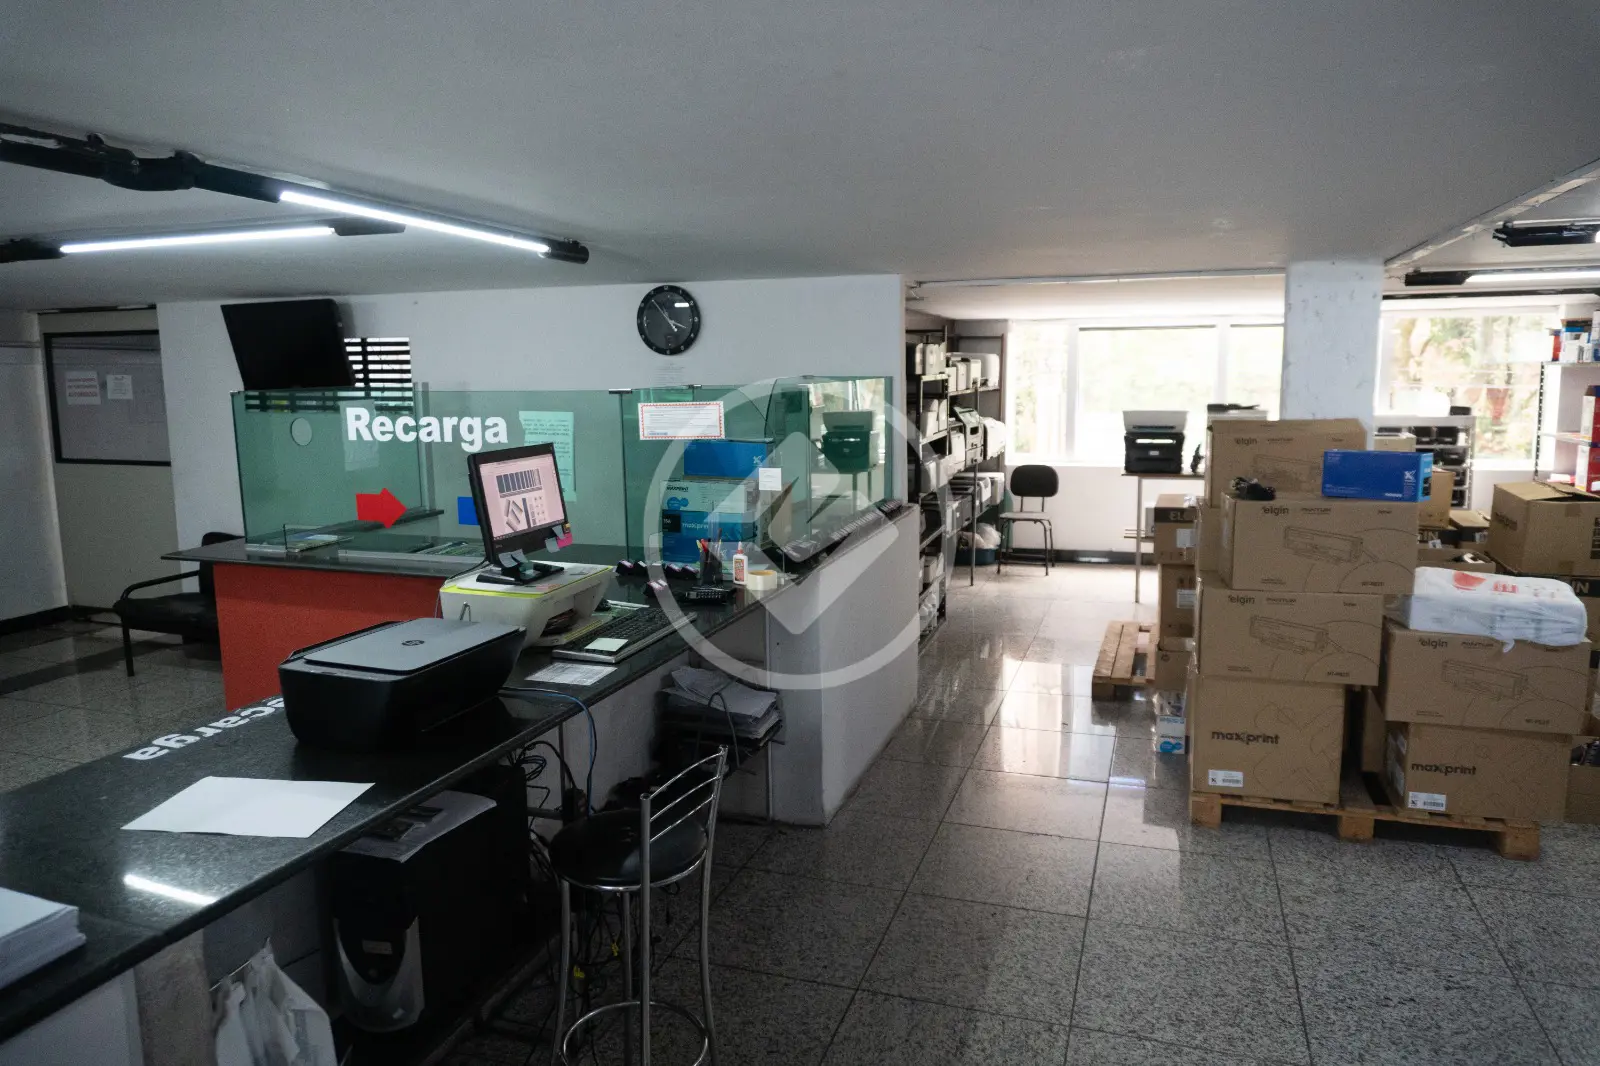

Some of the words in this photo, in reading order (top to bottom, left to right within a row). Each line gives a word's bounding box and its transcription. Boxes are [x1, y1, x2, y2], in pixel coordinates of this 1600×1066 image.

[346, 407, 508, 452] Recarga
[1262, 506, 1290, 516] elgin
[1228, 594, 1256, 605] elgin
[1419, 637, 1449, 649] elgin
[123, 697, 285, 761] ecarga
[1211, 731, 1280, 745] maxprint
[1411, 763, 1477, 776] maxprint
